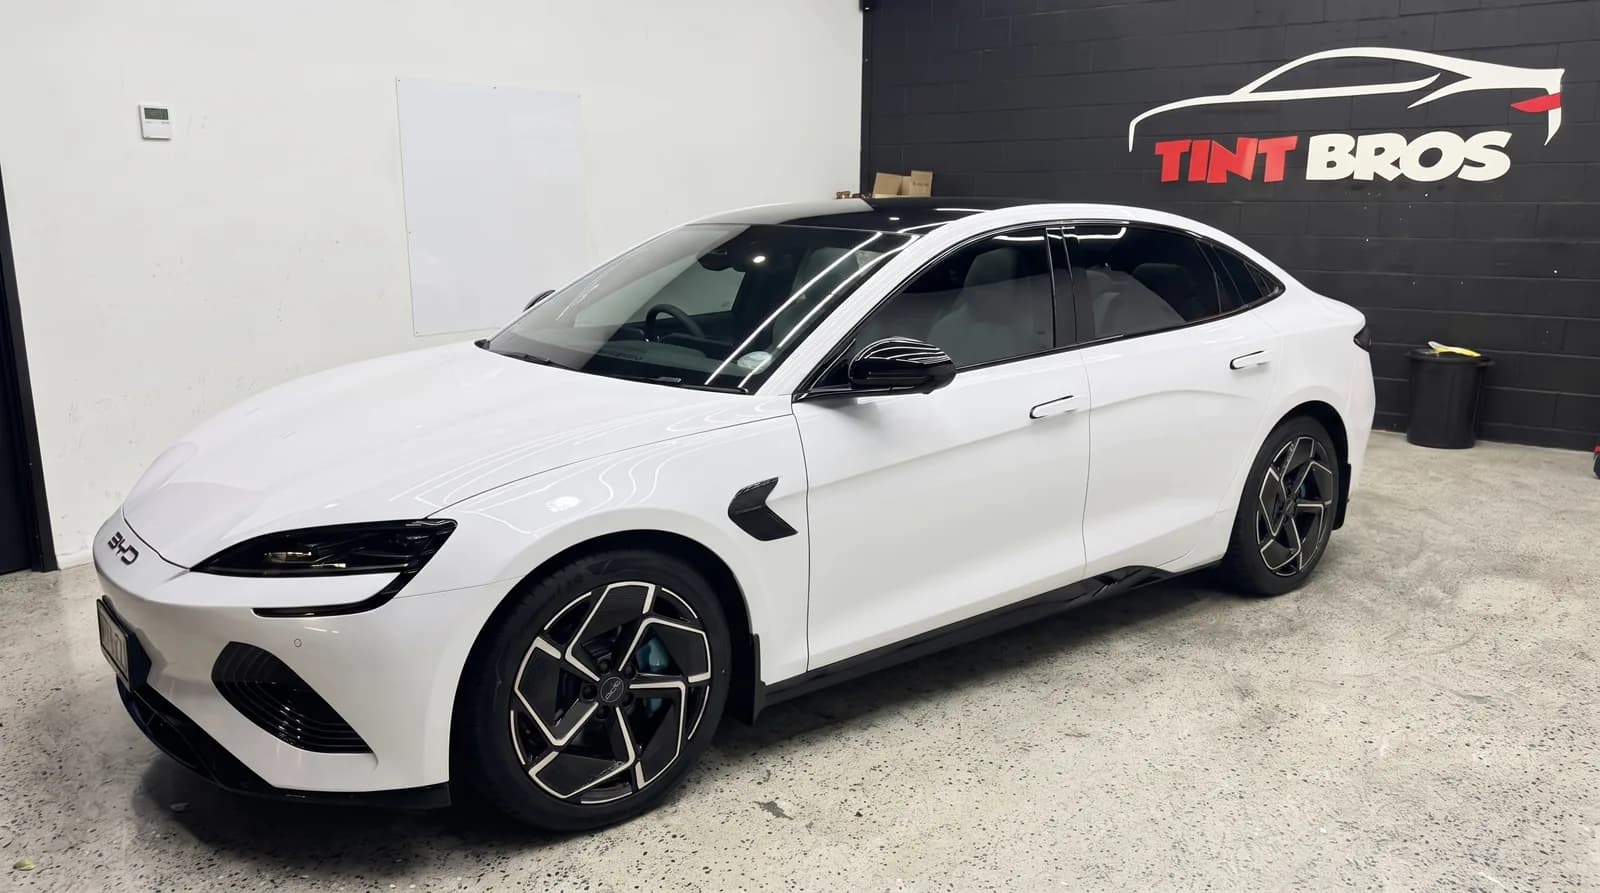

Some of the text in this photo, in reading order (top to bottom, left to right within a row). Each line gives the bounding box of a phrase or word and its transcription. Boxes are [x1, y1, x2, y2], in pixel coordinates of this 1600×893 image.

[1155, 131, 1512, 183] TINT BROS
[107, 531, 139, 566] BYD
